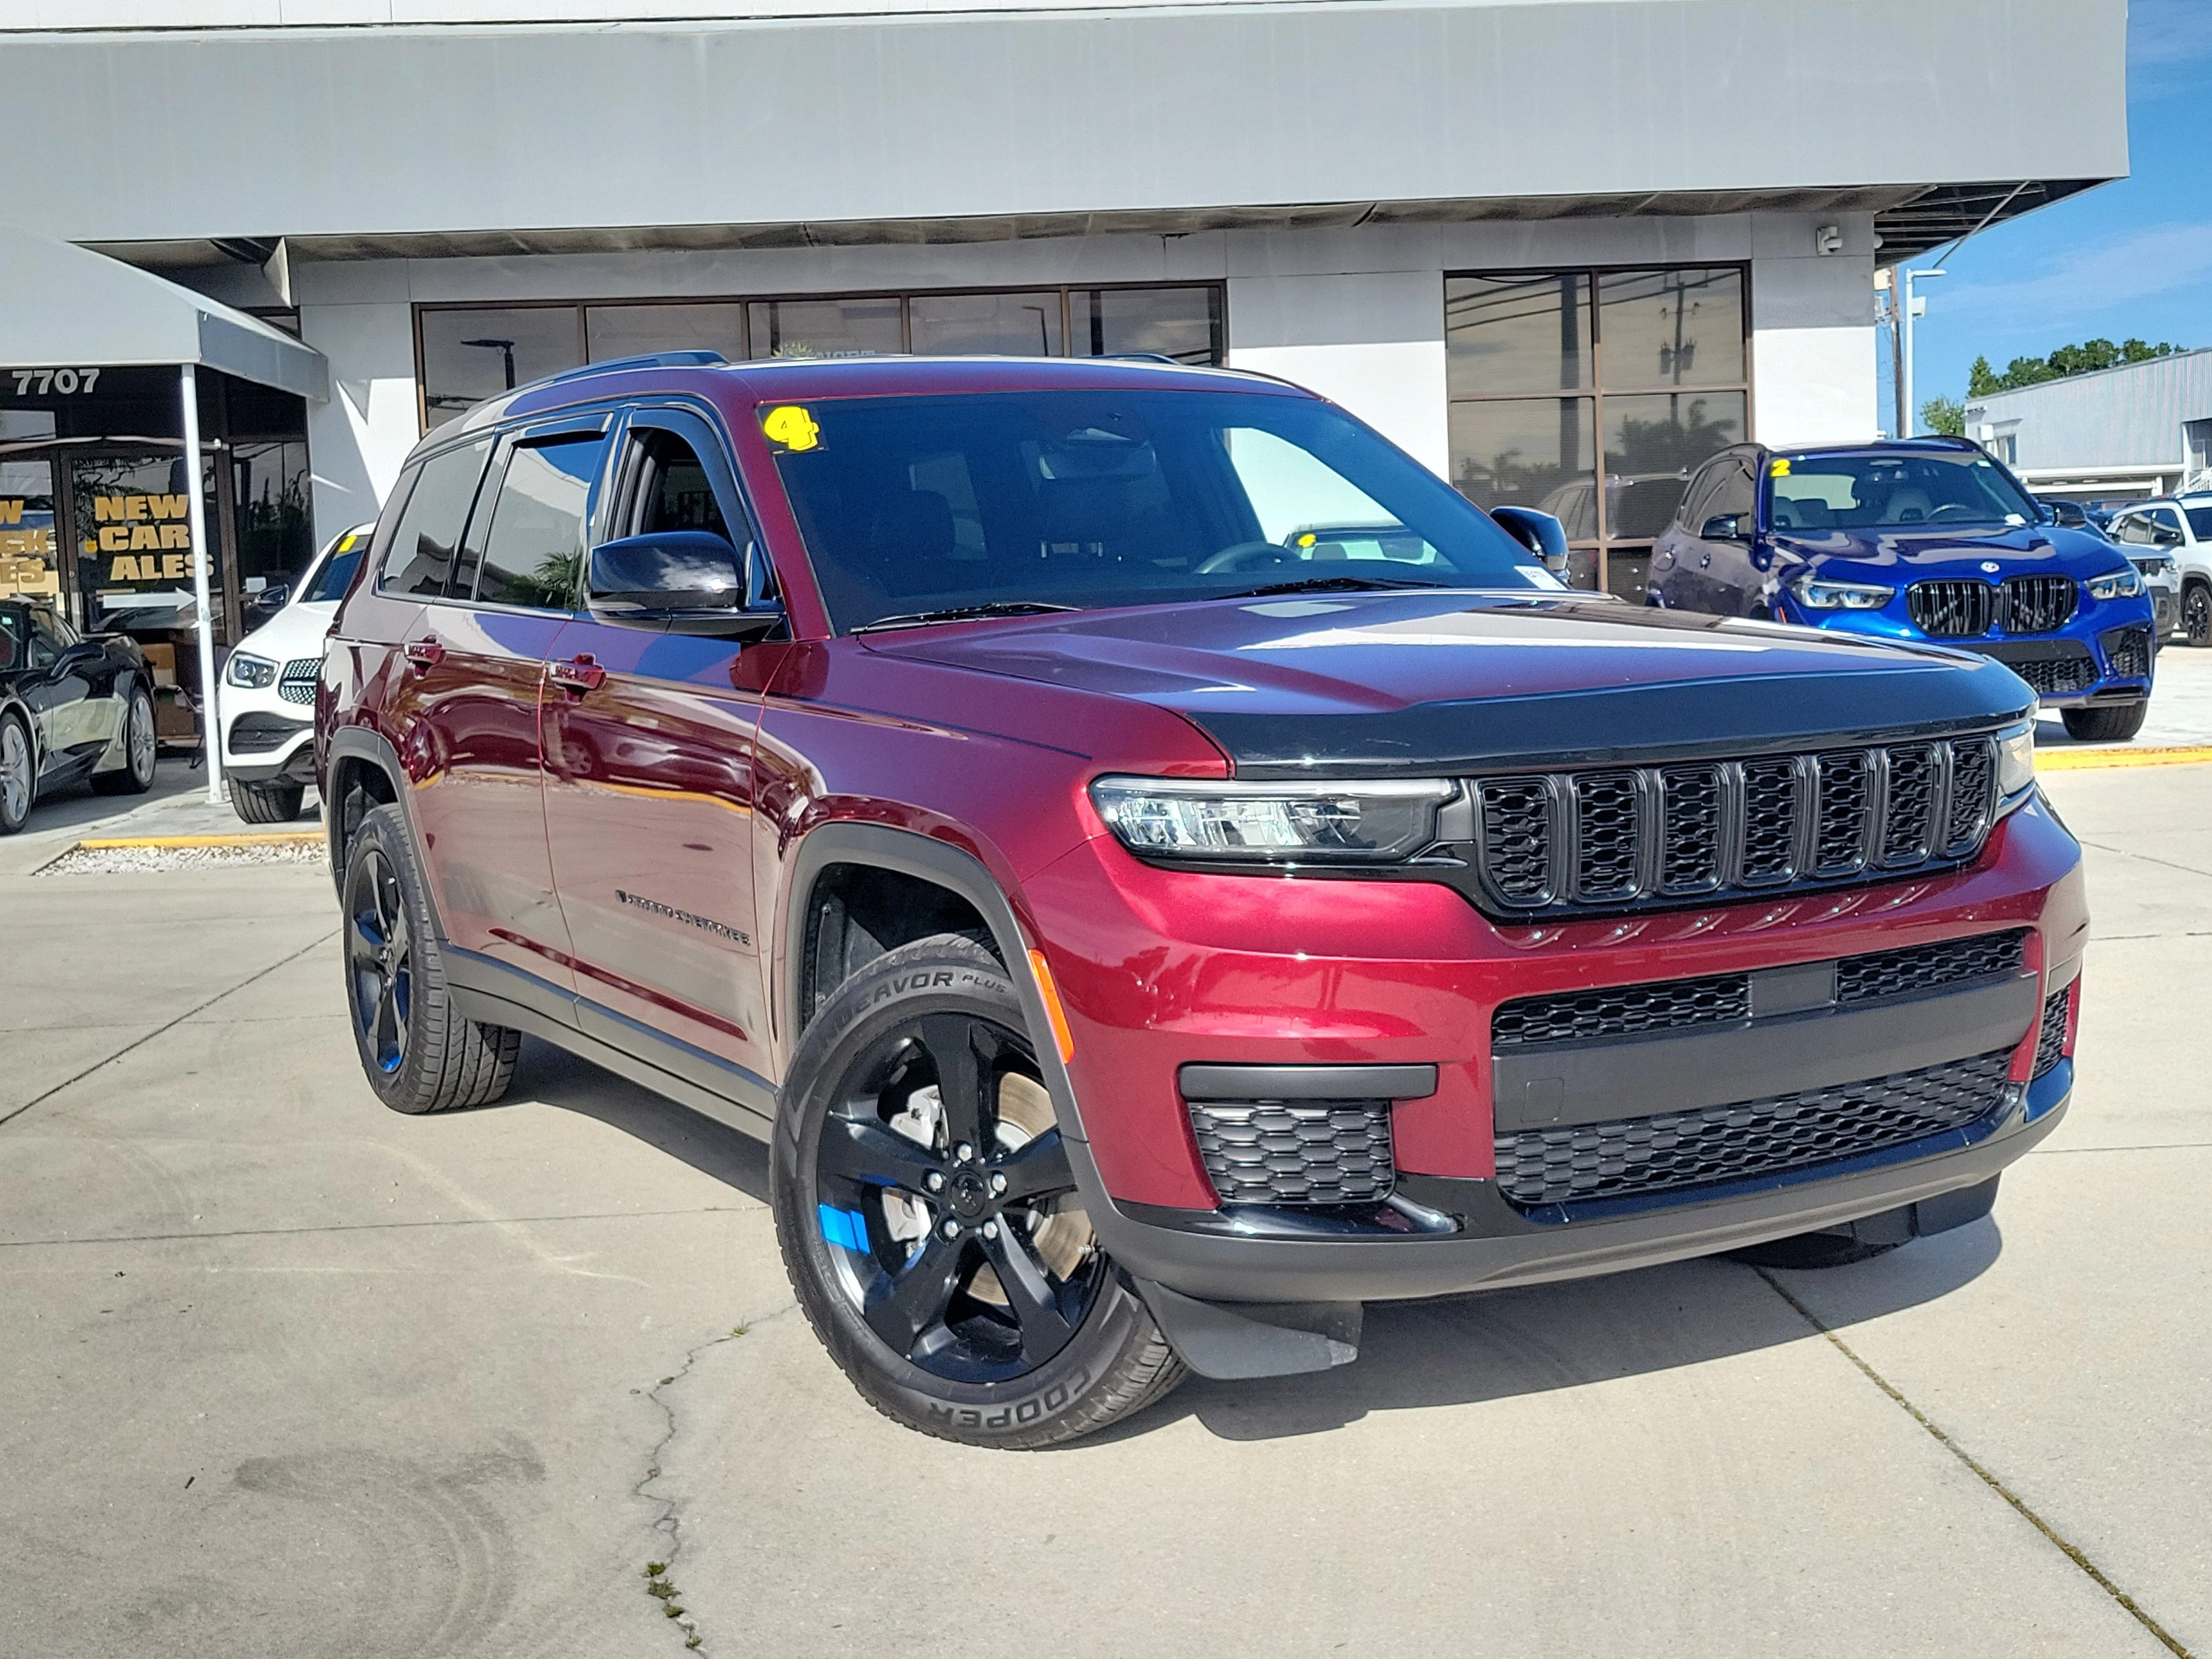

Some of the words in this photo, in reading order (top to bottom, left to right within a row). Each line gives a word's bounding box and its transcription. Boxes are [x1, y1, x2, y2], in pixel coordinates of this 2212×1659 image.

[13, 368, 100, 396] 7707
[764, 406, 819, 451] 4
[1771, 459, 1790, 477] 2
[94, 494, 189, 521] NEW
[99, 524, 190, 551] CAR
[961, 974, 1007, 994] PLUS
[927, 1363, 1093, 1428] COOPER
